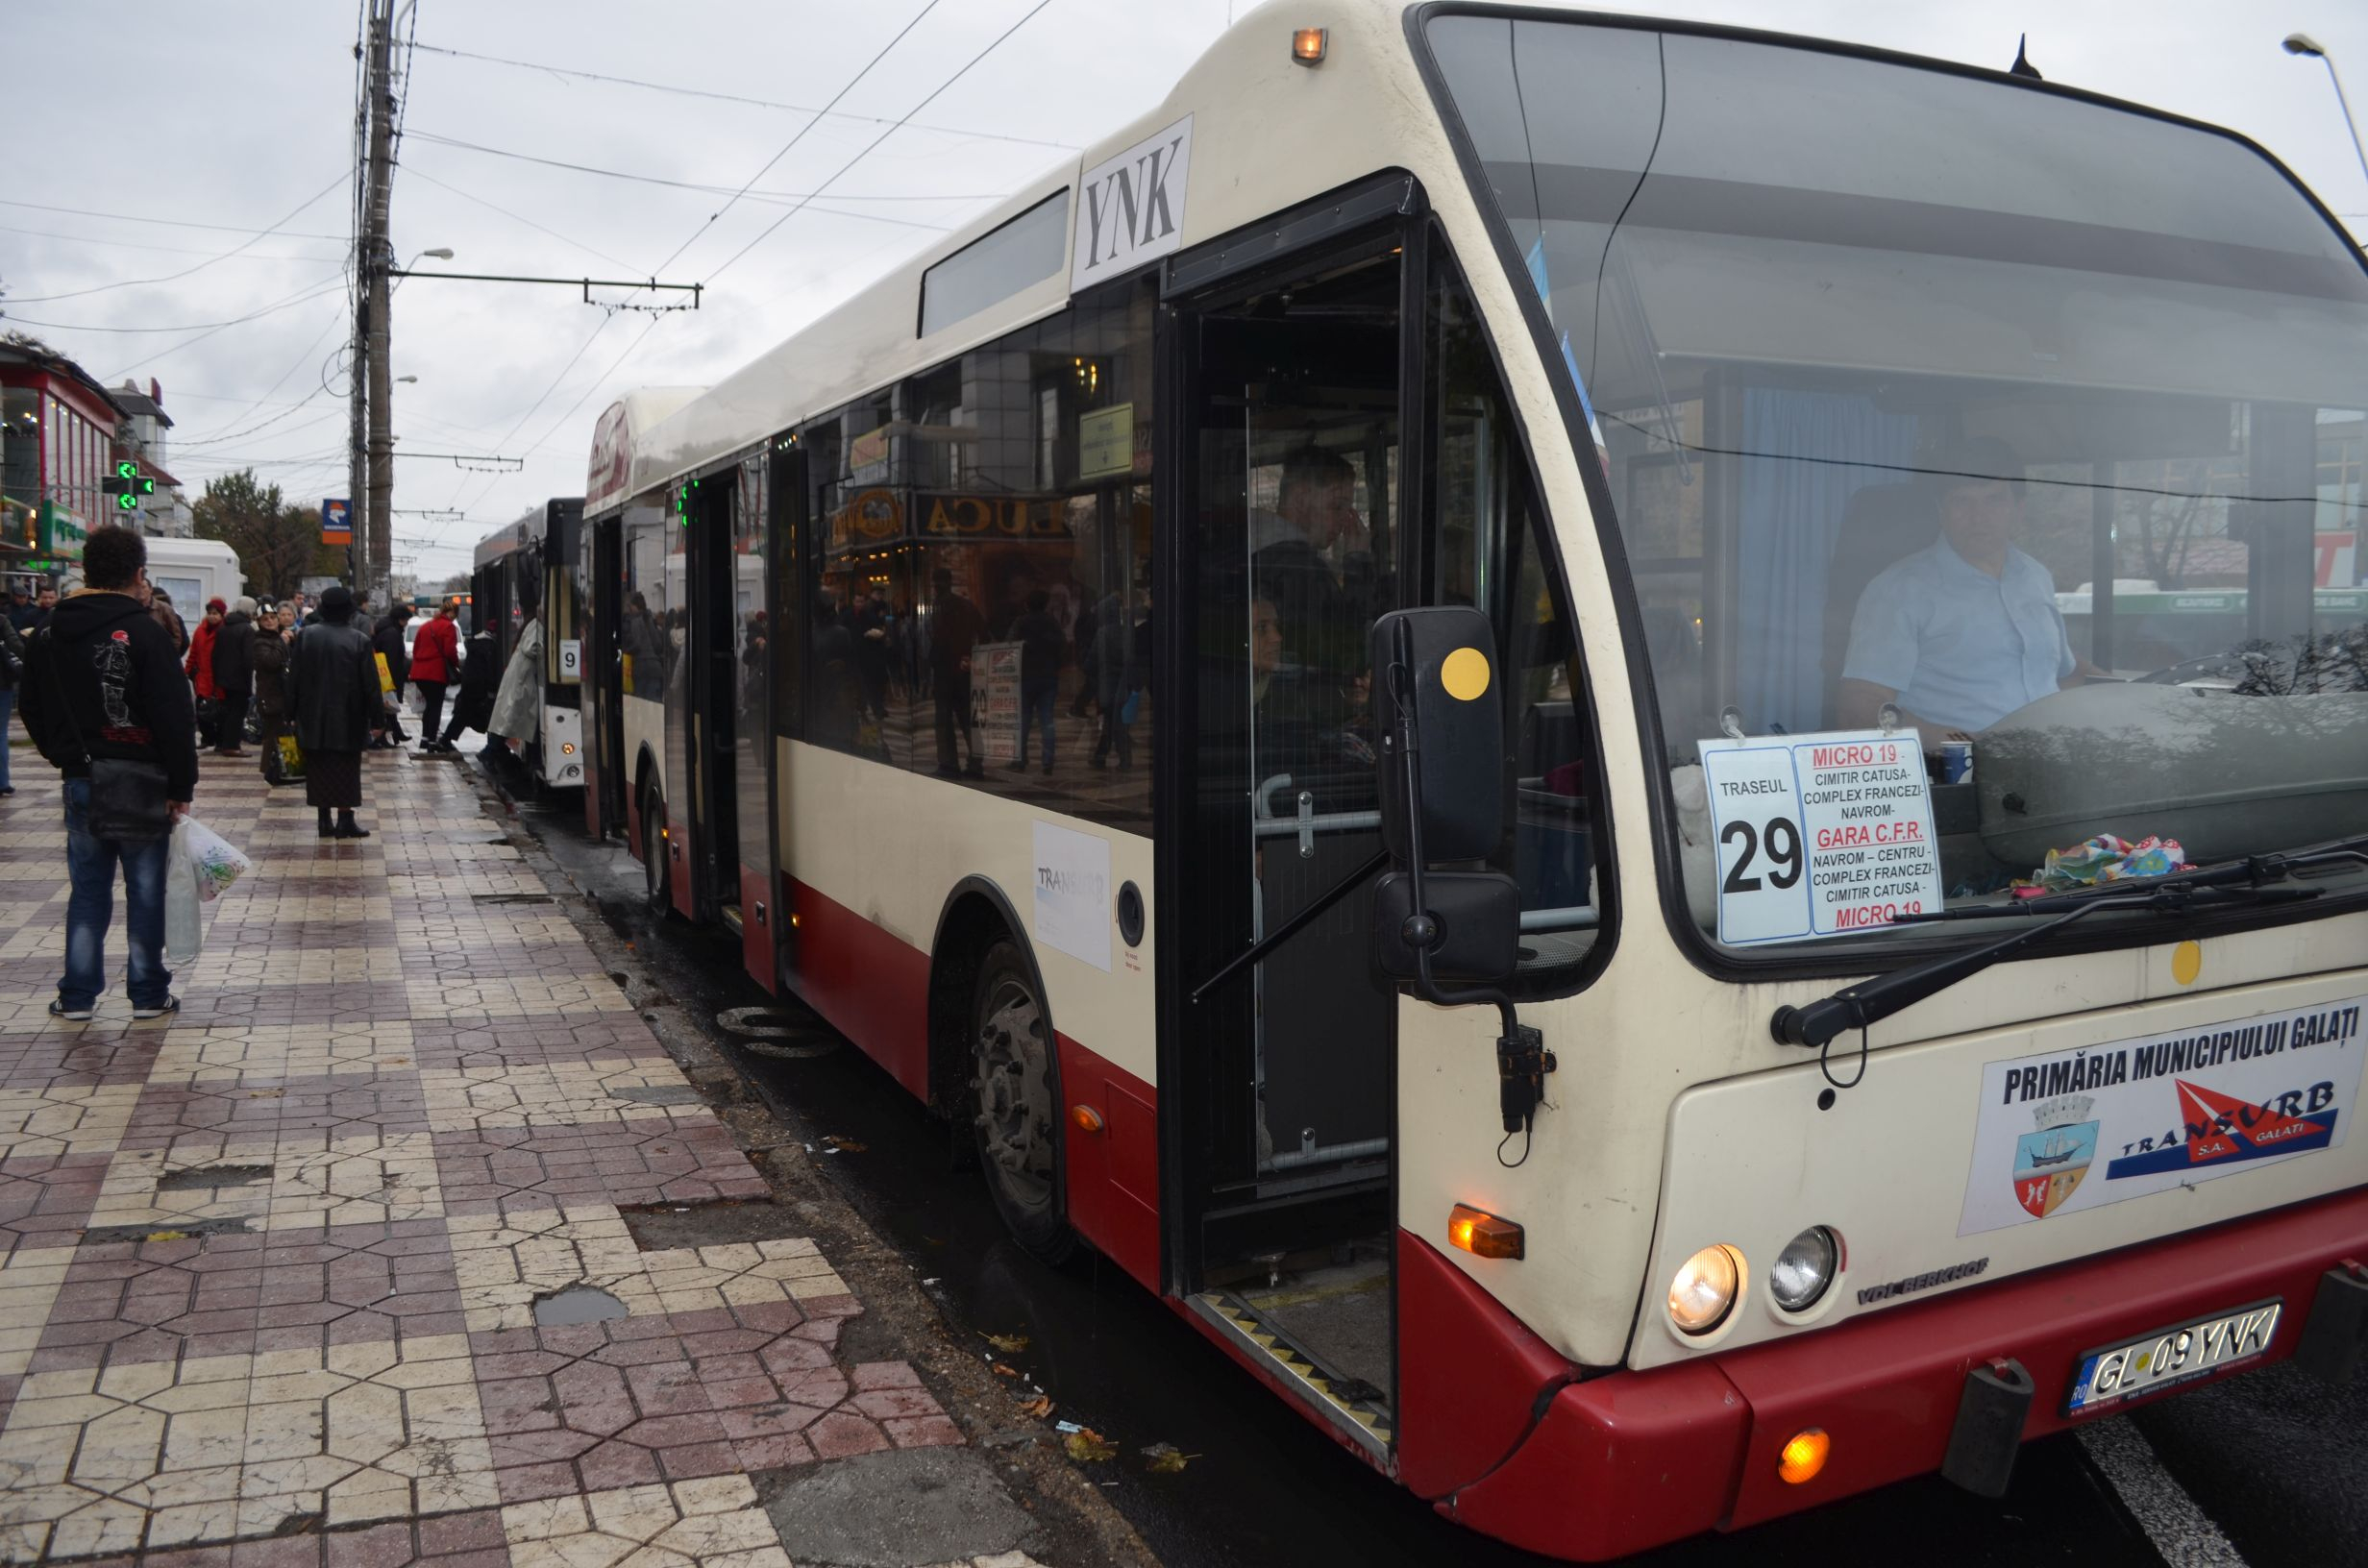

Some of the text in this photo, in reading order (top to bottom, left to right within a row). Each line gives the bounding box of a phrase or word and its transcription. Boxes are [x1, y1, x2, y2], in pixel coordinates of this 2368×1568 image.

[1084, 135, 1184, 271] YNK
[565, 651, 576, 669] 9
[1813, 747, 1873, 768] MICRO
[1878, 744, 1897, 762] 19
[1720, 778, 1788, 796] TRASEUL
[1814, 772, 1860, 786] CIMITIR
[1804, 788, 1862, 805] COMPLEX
[1816, 821, 1923, 848] GARA C.F.R.
[1720, 817, 1803, 894] 29
[1813, 851, 1864, 869] NAVROM
[1877, 845, 1925, 863] CENTRU
[1813, 870, 1871, 886] COMPLEX
[1826, 887, 1870, 903] CIMITIR
[1873, 881, 1920, 898] CATUSA
[1835, 903, 1899, 929] MICRO
[2003, 1050, 2127, 1105] PRIMĂRIA
[2132, 1019, 2288, 1081] MUNICIPIULUI
[2121, 1080, 2334, 1157] TRANSURB
[2198, 1122, 2305, 1156] S.A. GALATI
[1857, 1257, 1989, 1306] VDL BERKHOF
[2092, 1348, 2136, 1393] GL
[2149, 1328, 2194, 1378] 09
[2198, 1310, 2272, 1365] YNK
[2071, 1384, 2088, 1401] RO
